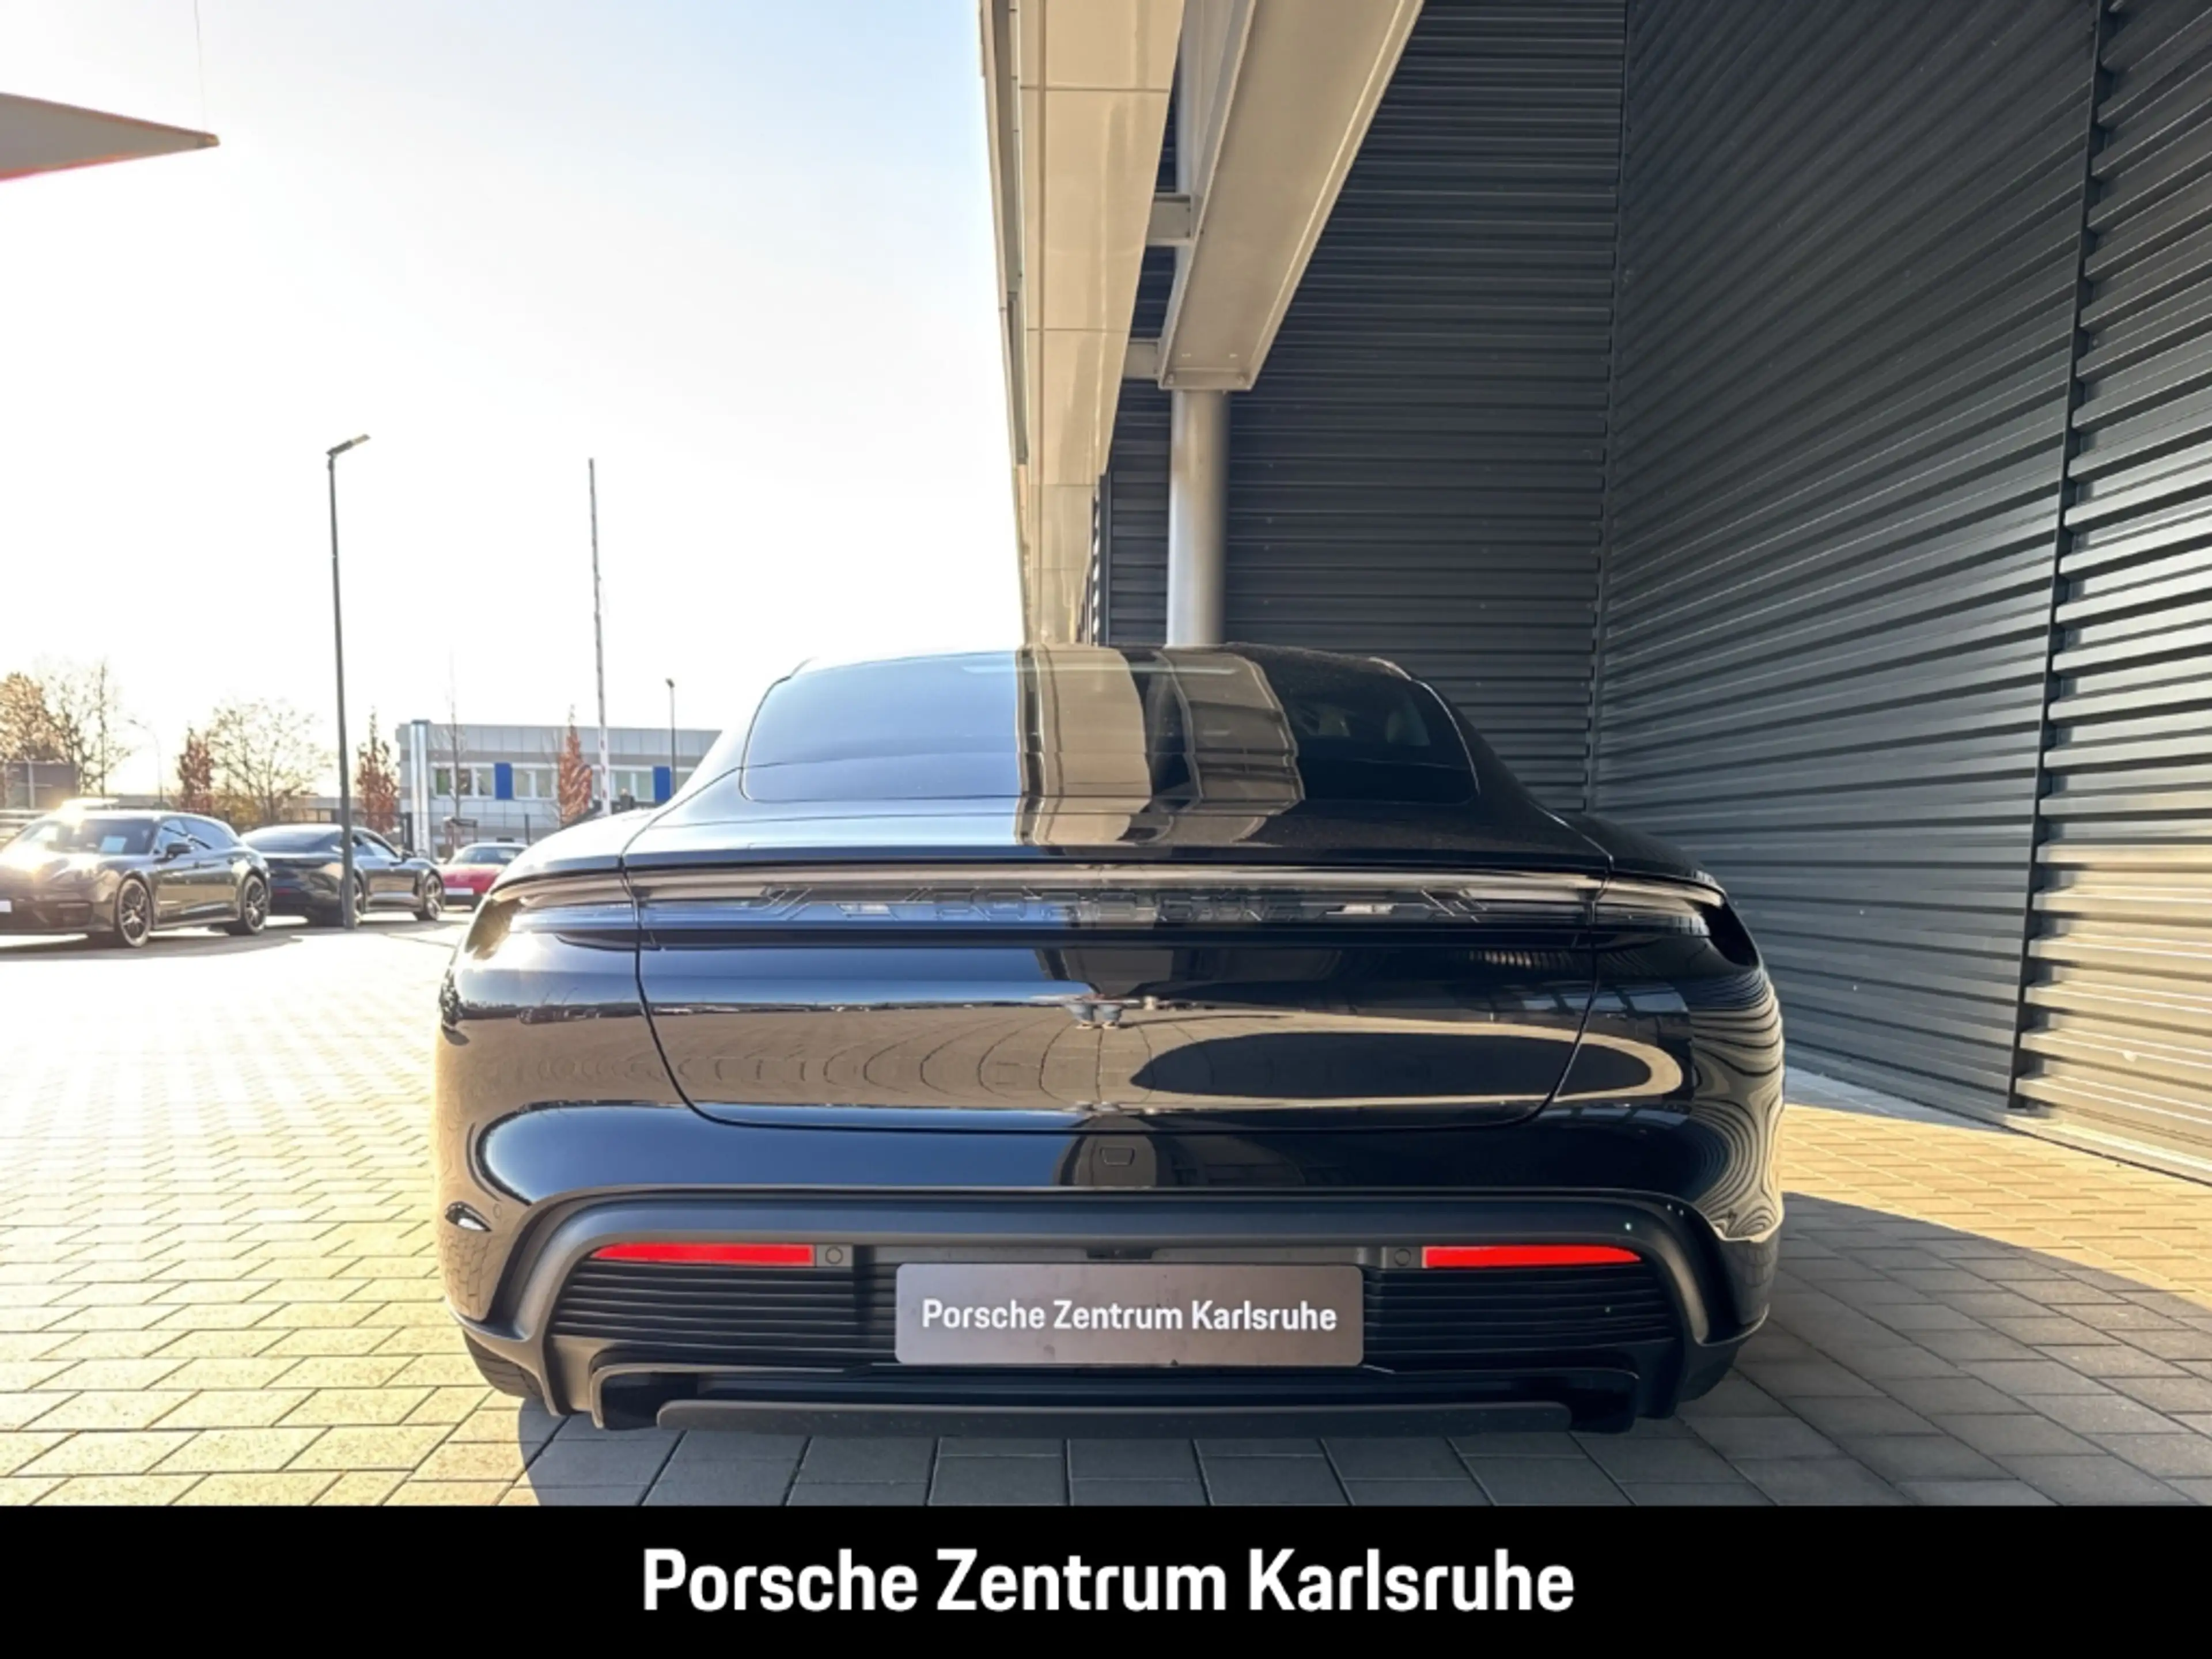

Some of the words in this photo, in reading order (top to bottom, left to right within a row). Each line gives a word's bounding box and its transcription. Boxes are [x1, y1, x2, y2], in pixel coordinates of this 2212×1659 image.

[923, 1299, 1045, 1328] Porsche
[1054, 1300, 1182, 1330] Zentrum
[1192, 1300, 1337, 1331] Karlsruhe
